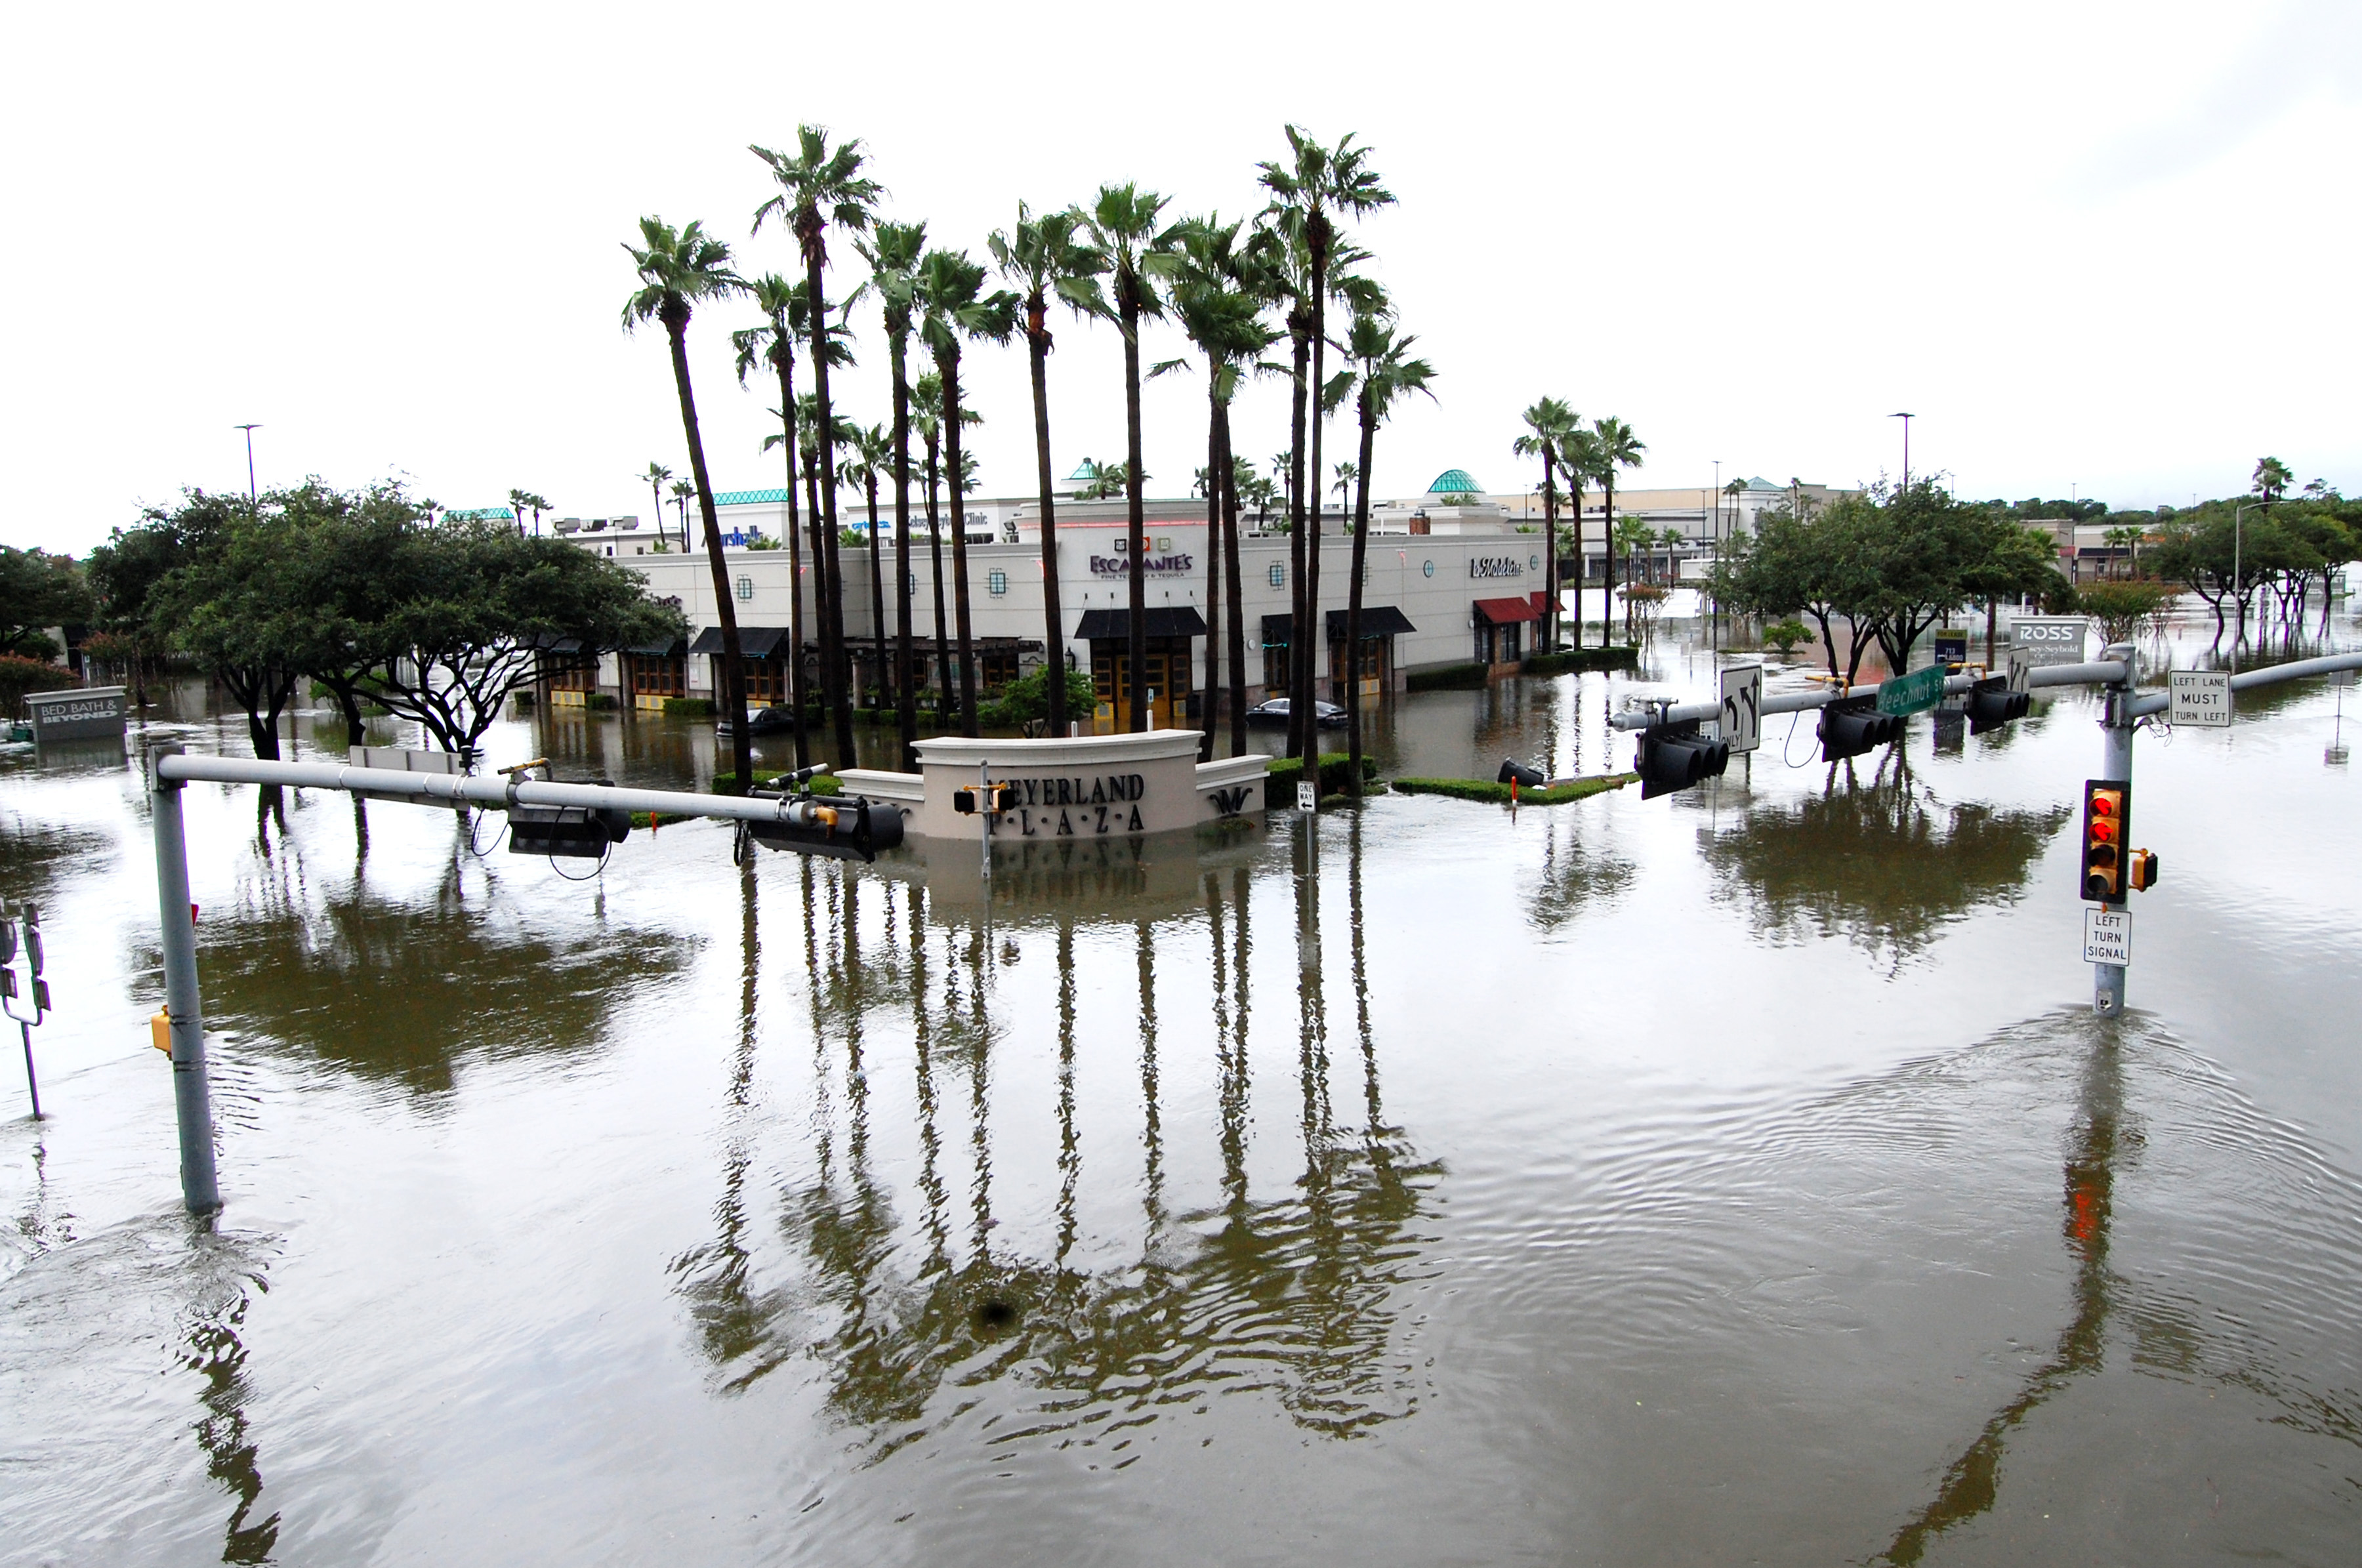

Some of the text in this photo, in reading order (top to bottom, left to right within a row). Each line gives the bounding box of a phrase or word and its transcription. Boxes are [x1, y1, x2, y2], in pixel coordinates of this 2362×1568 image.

[964, 512, 987, 526] Clinic
[1090, 554, 1193, 573] ESCAANTE'S
[2020, 626, 2073, 640] ROSS
[2016, 644, 2079, 653] sey-Seybold
[2174, 677, 2226, 687] LEFT LANE
[2182, 693, 2218, 705] MUST
[42, 699, 117, 716] BED BATH &
[43, 711, 118, 724] BEYOND
[2175, 711, 2226, 721] TURN LEFT
[1299, 784, 1313, 793] ONE
[2096, 915, 2121, 927] LEFT
[2094, 931, 2121, 943] TURN
[2088, 946, 2126, 960] SIGNAL
